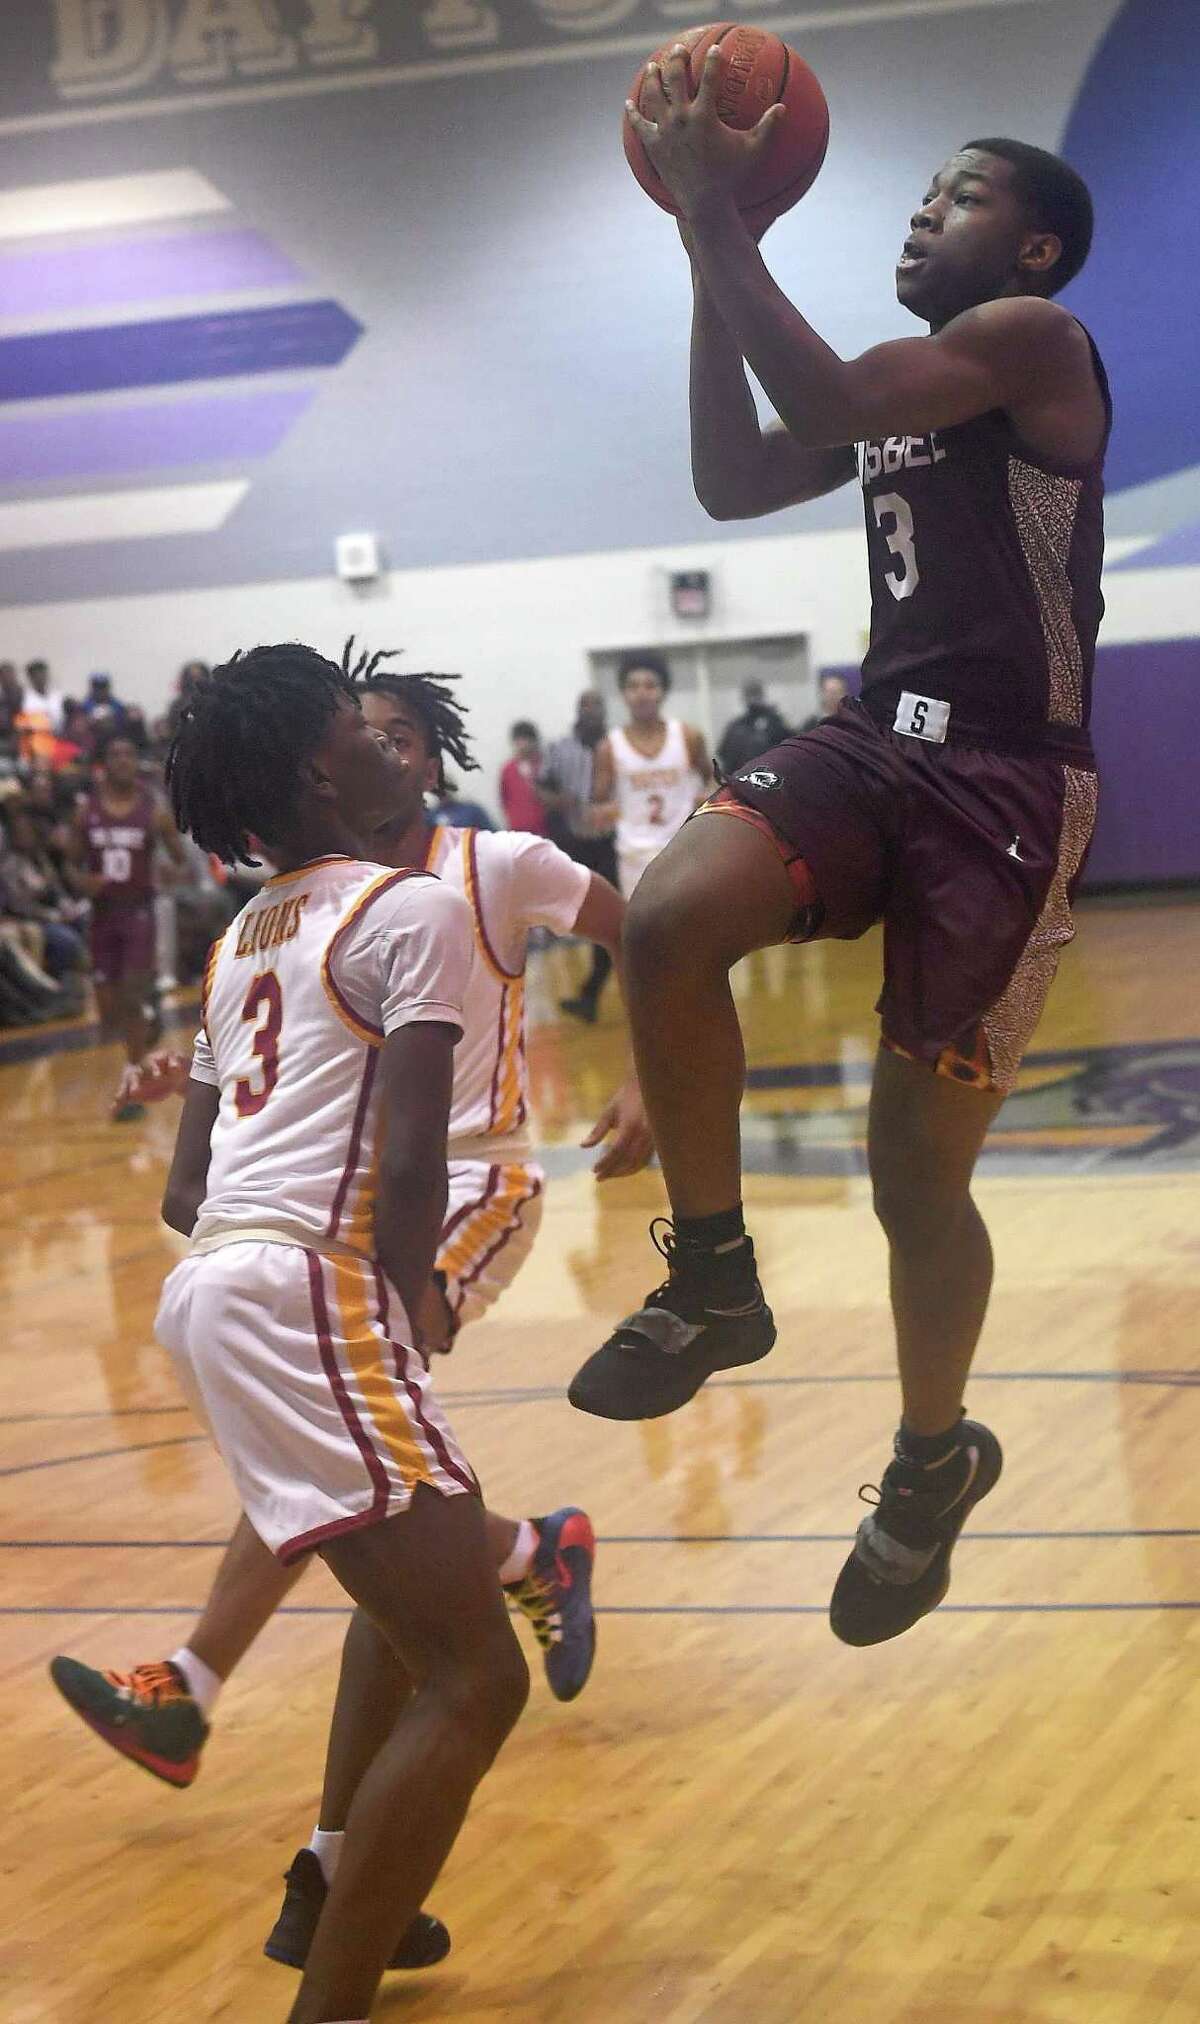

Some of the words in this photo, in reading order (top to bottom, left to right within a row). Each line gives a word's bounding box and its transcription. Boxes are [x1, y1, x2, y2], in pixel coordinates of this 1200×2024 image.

[872, 491, 921, 602] 3
[910, 701, 929, 734] S
[234, 892, 309, 960] LIONS
[233, 969, 284, 1120] 3
